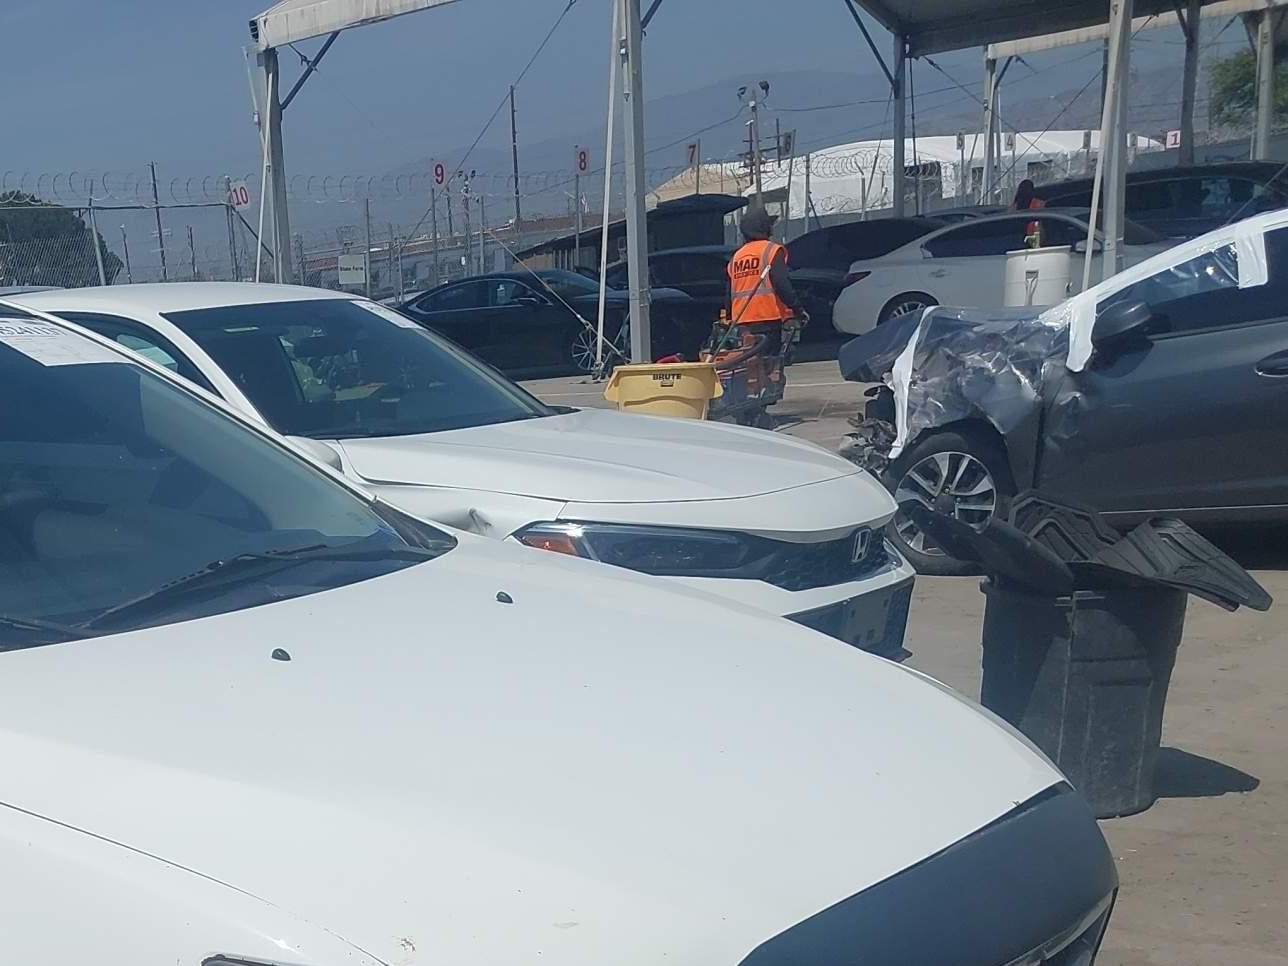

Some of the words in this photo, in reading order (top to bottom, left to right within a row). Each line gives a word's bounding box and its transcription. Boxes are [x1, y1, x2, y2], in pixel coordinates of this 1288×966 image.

[1170, 132, 1180, 146] 1
[578, 150, 587, 171] 8
[688, 143, 697, 162] 7
[434, 163, 445, 185] 9
[232, 186, 249, 206] 10
[733, 257, 760, 274] MAD
[652, 373, 681, 381] BRUTE
